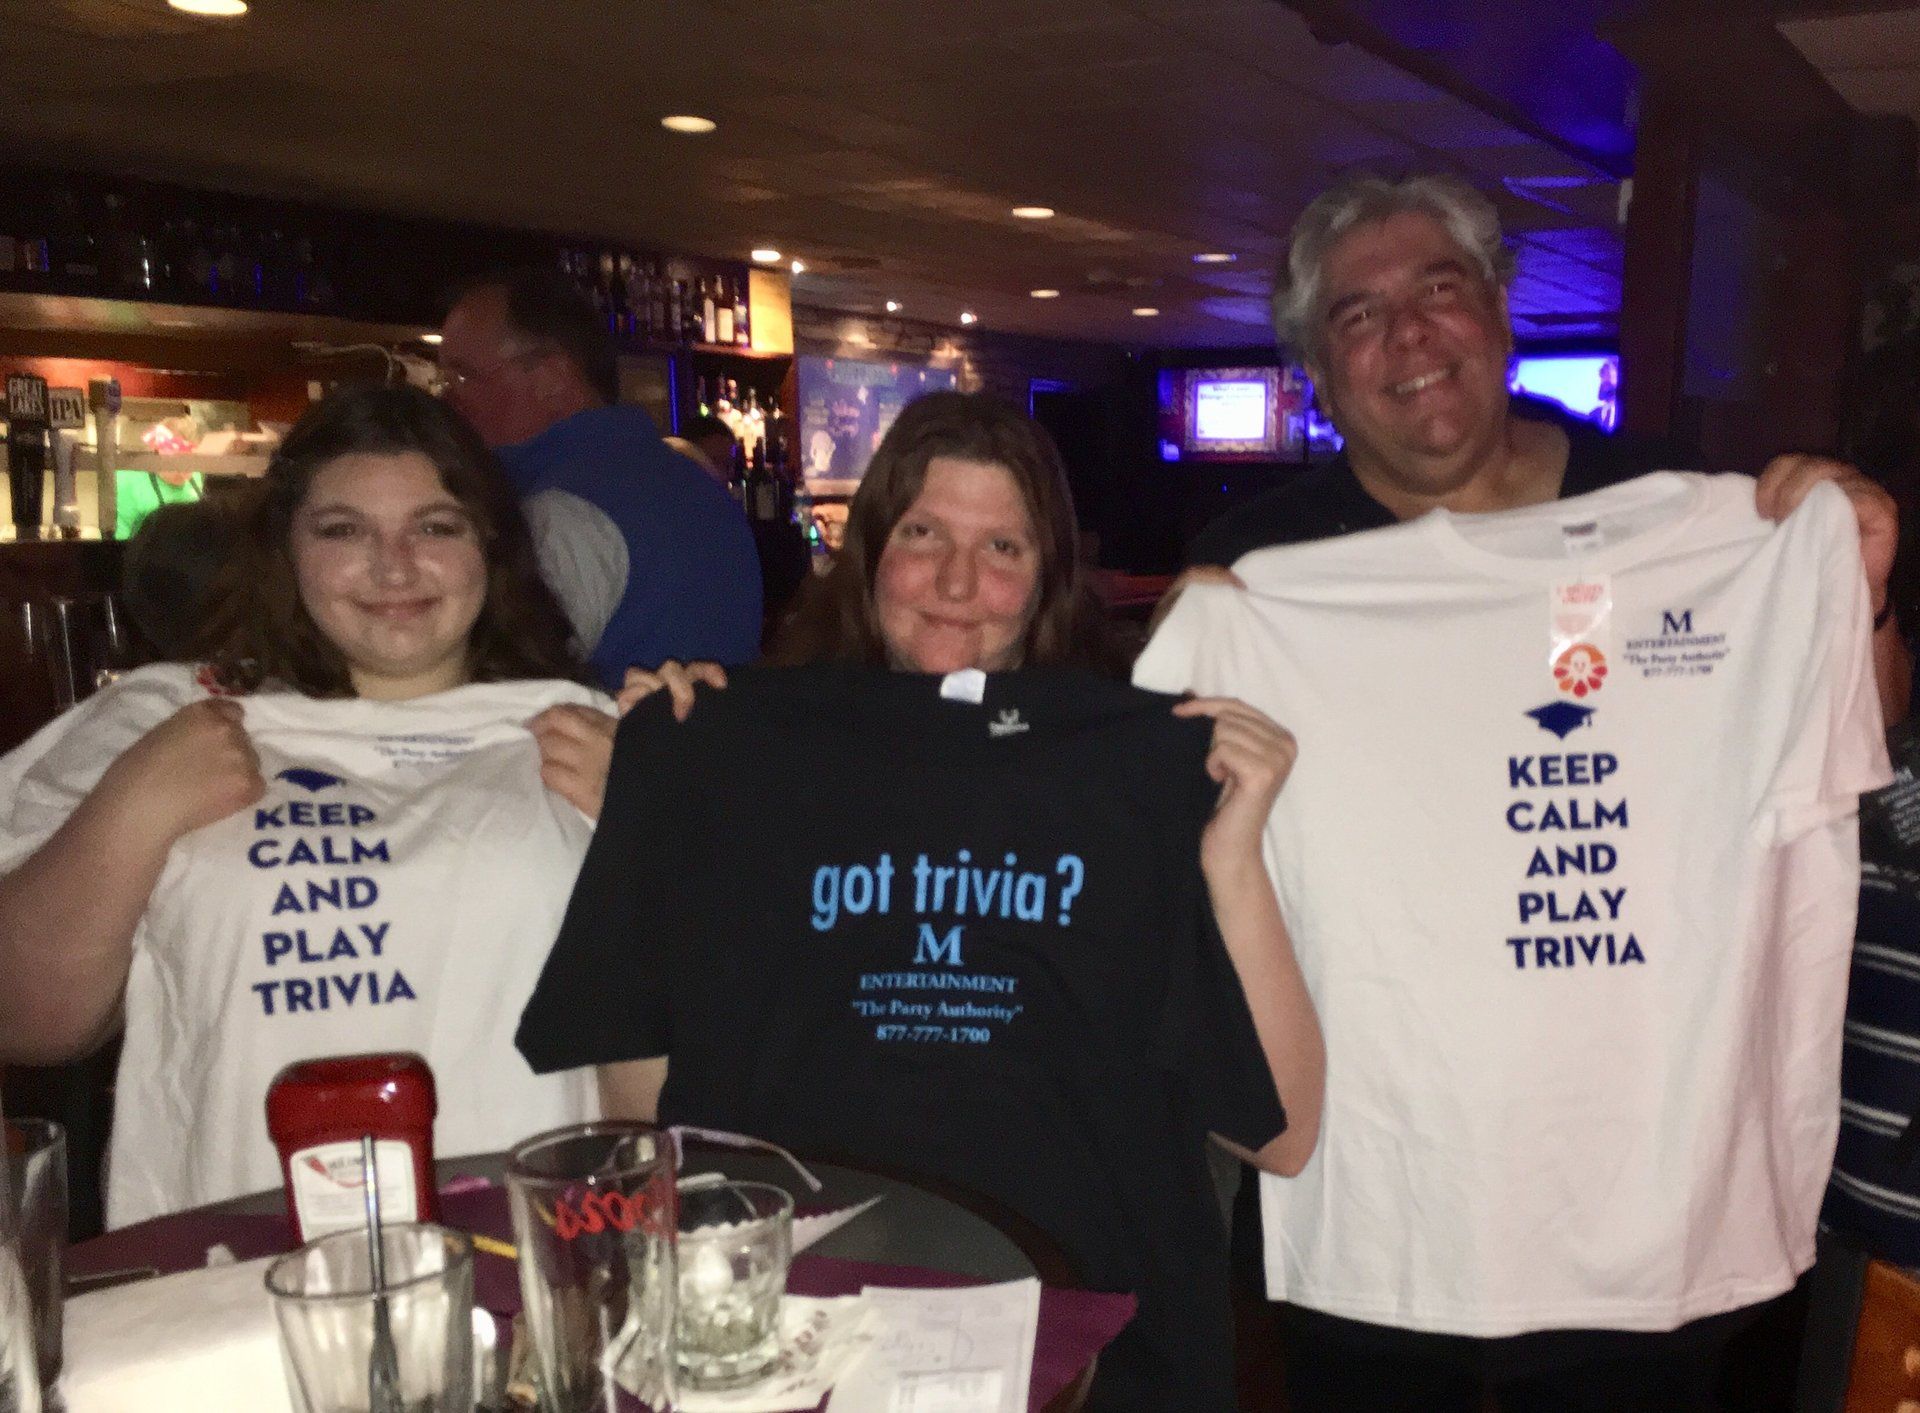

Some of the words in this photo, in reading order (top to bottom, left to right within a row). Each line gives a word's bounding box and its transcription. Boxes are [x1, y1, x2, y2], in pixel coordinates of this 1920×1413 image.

[1661, 608, 1694, 636] M
[1508, 753, 1618, 788] KEEP
[255, 801, 376, 830] KEEP
[1506, 798, 1629, 832] CALM
[247, 836, 391, 869] CALM
[1526, 843, 1618, 878] AND
[271, 876, 379, 916] AND
[811, 853, 895, 931] got
[1518, 887, 1627, 924] PLAY
[262, 921, 391, 966] PLAY
[913, 923, 966, 966] M
[1506, 932, 1646, 969] TRIVIA
[252, 969, 417, 1015] TRIVIA
[860, 973, 1018, 993] ENTERTAINMENT
[889, 1000, 932, 1020] Party
[876, 1024, 992, 1042] 877-777-1700
